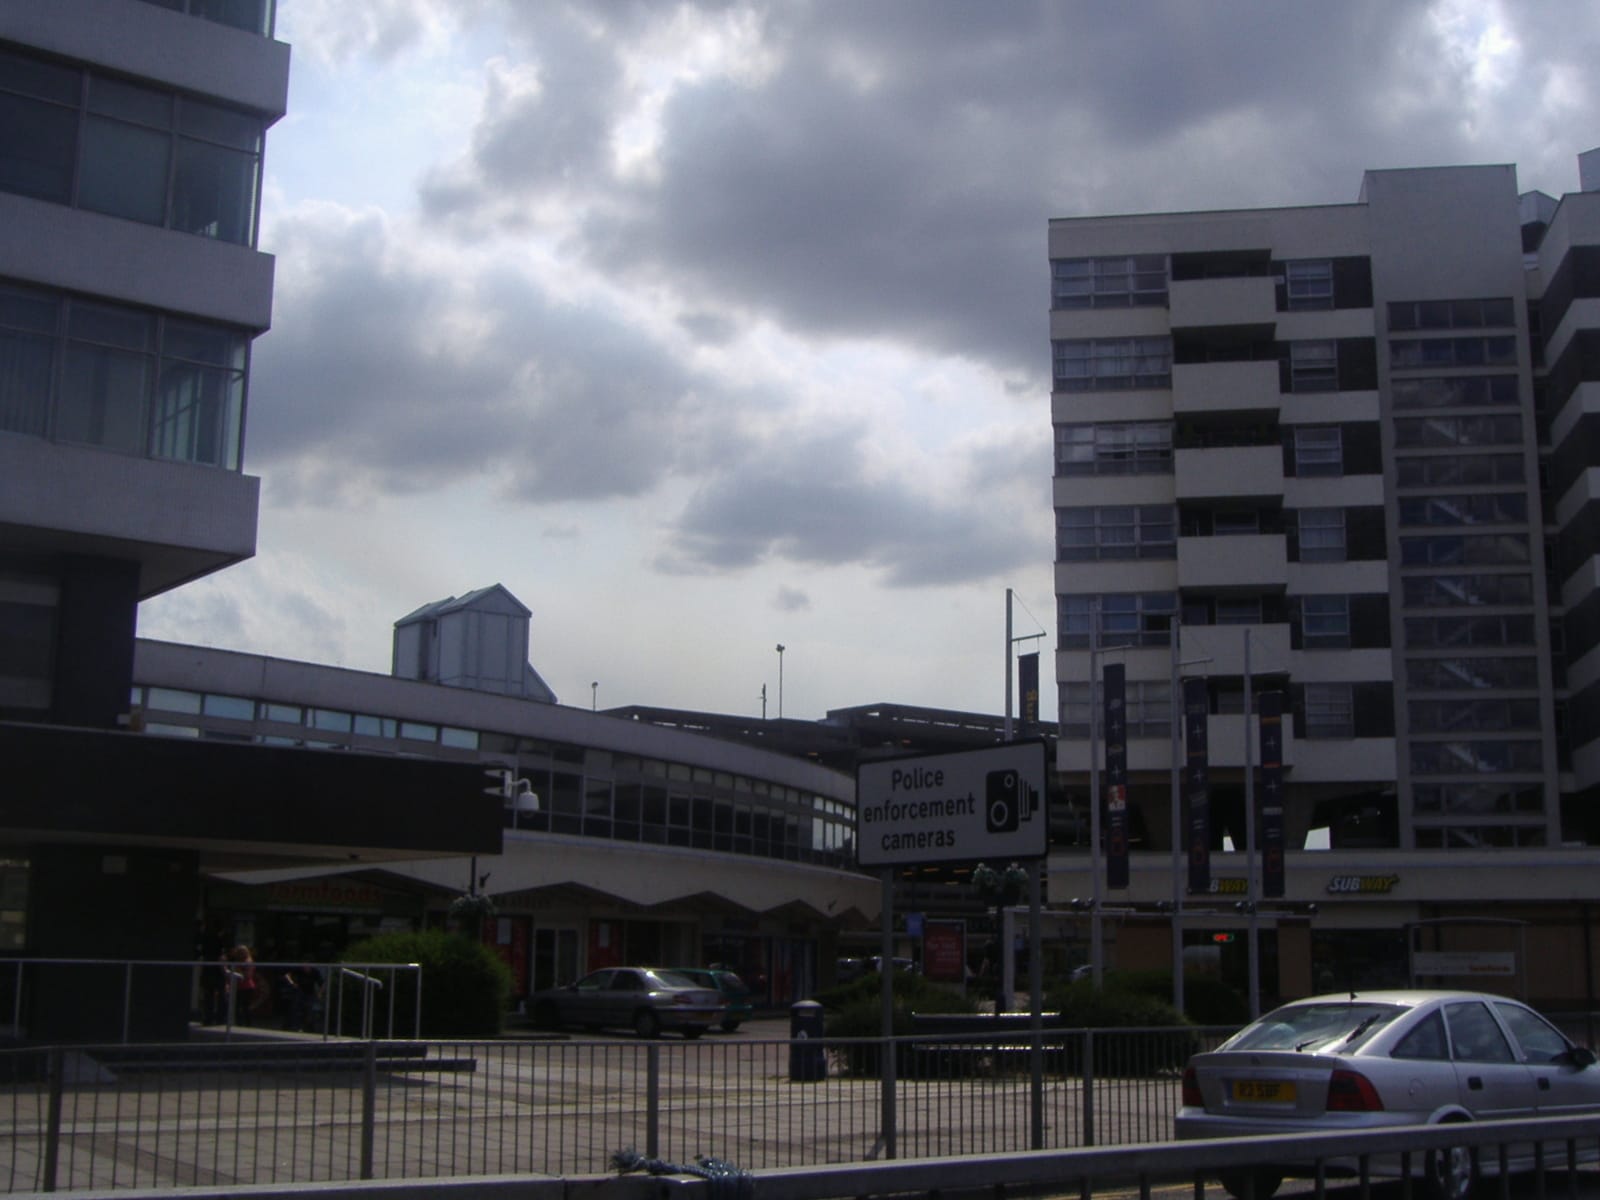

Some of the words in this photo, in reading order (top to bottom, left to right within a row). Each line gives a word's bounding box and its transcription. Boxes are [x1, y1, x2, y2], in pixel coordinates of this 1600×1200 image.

[893, 768, 944, 792] Police
[864, 792, 975, 822] enforcement
[881, 829, 955, 850] cameras
[1209, 879, 1249, 893] BWAY
[1328, 874, 1399, 892] SUBWAY
